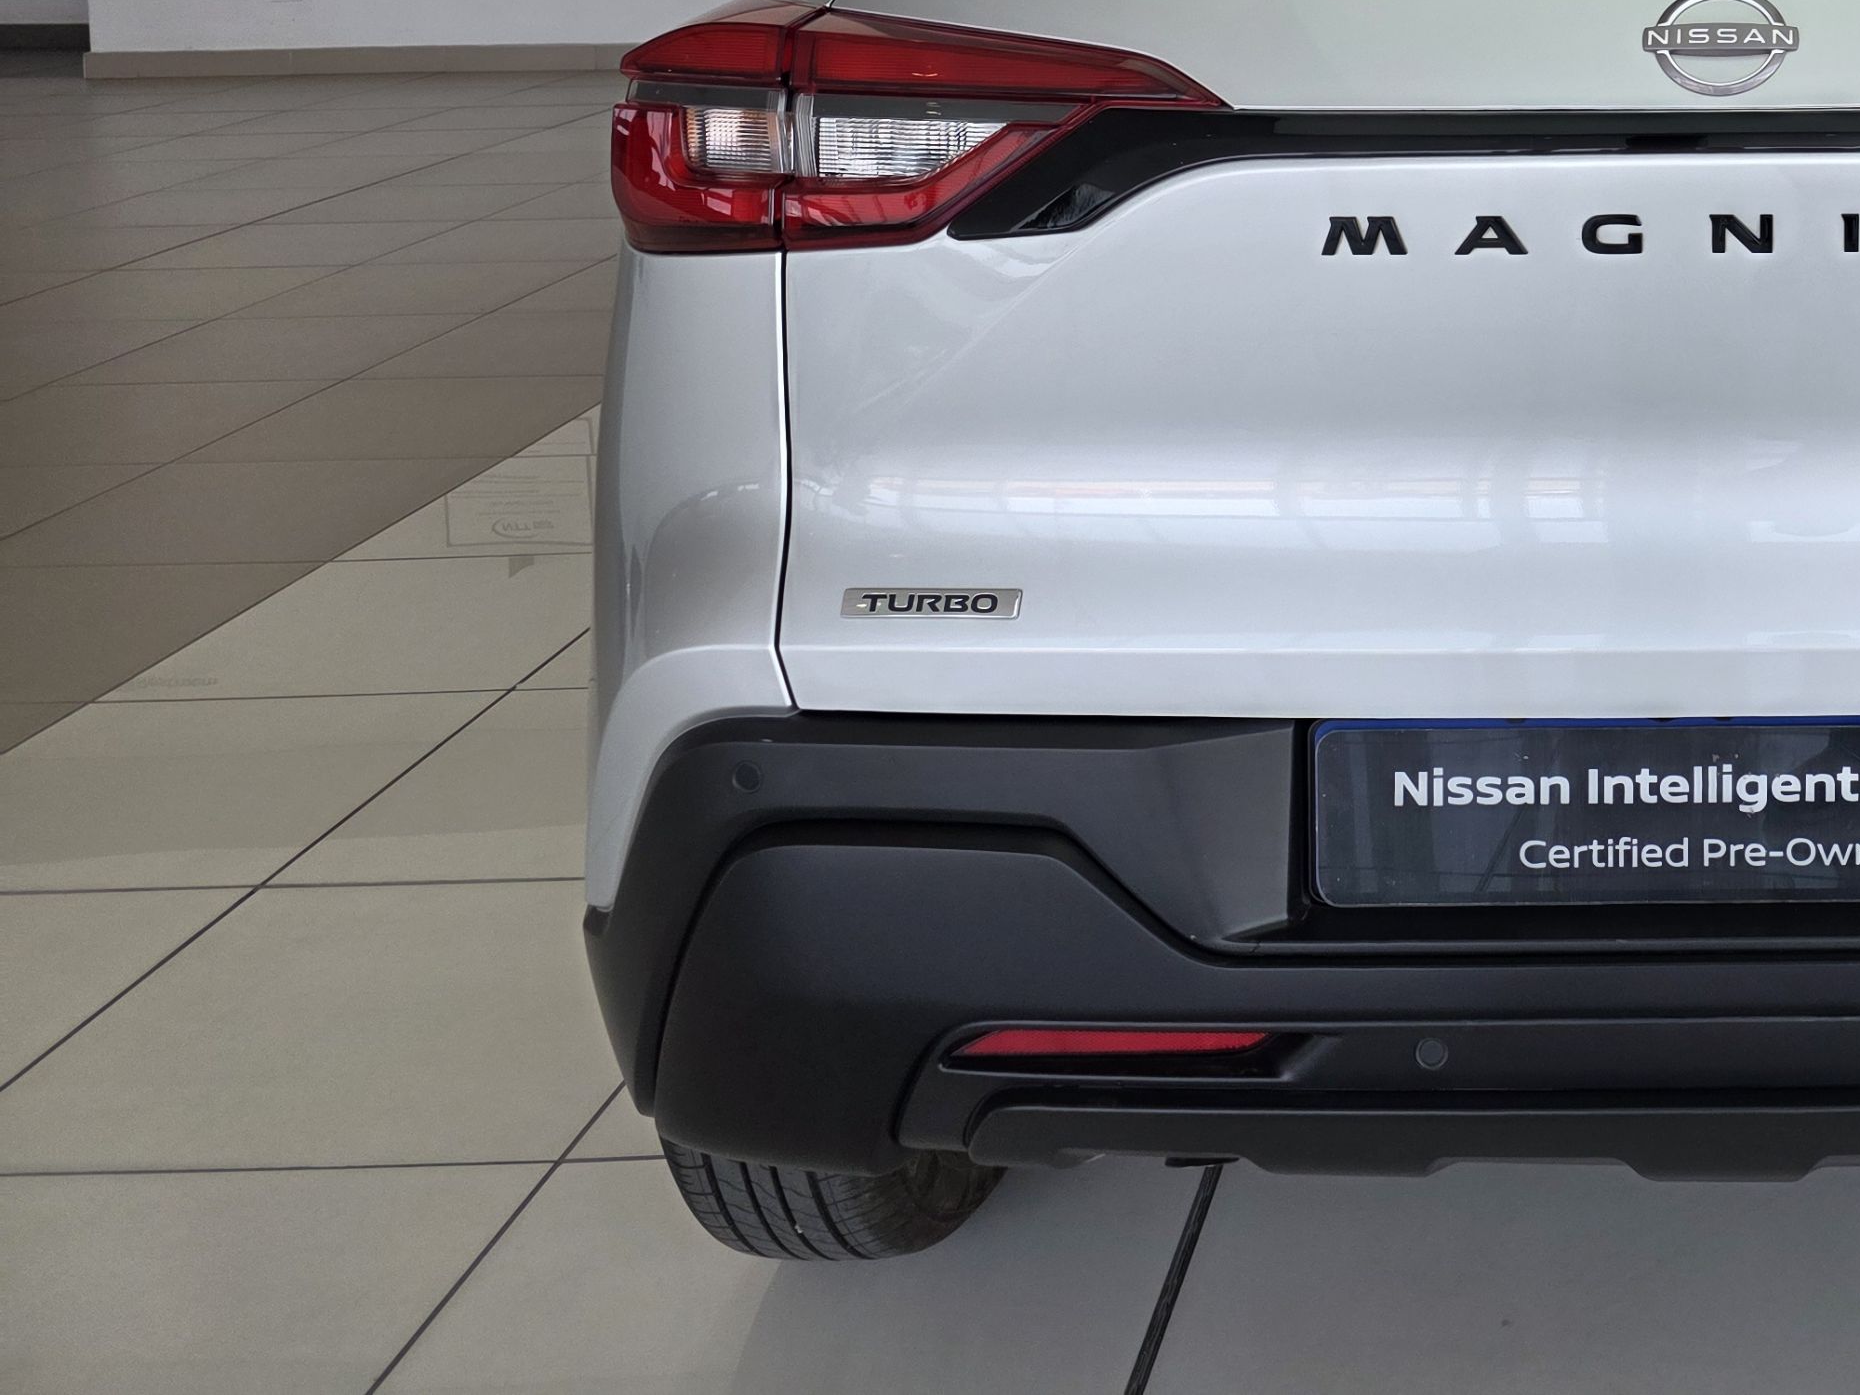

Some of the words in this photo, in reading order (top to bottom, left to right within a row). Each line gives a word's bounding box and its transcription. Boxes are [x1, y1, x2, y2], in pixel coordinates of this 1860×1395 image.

[1647, 28, 1794, 46] NISSAN
[861, 593, 999, 614] TURBO
[1393, 767, 1571, 807] Nissan
[1587, 763, 1860, 813] Intelligent
[1519, 837, 1690, 869] Certified
